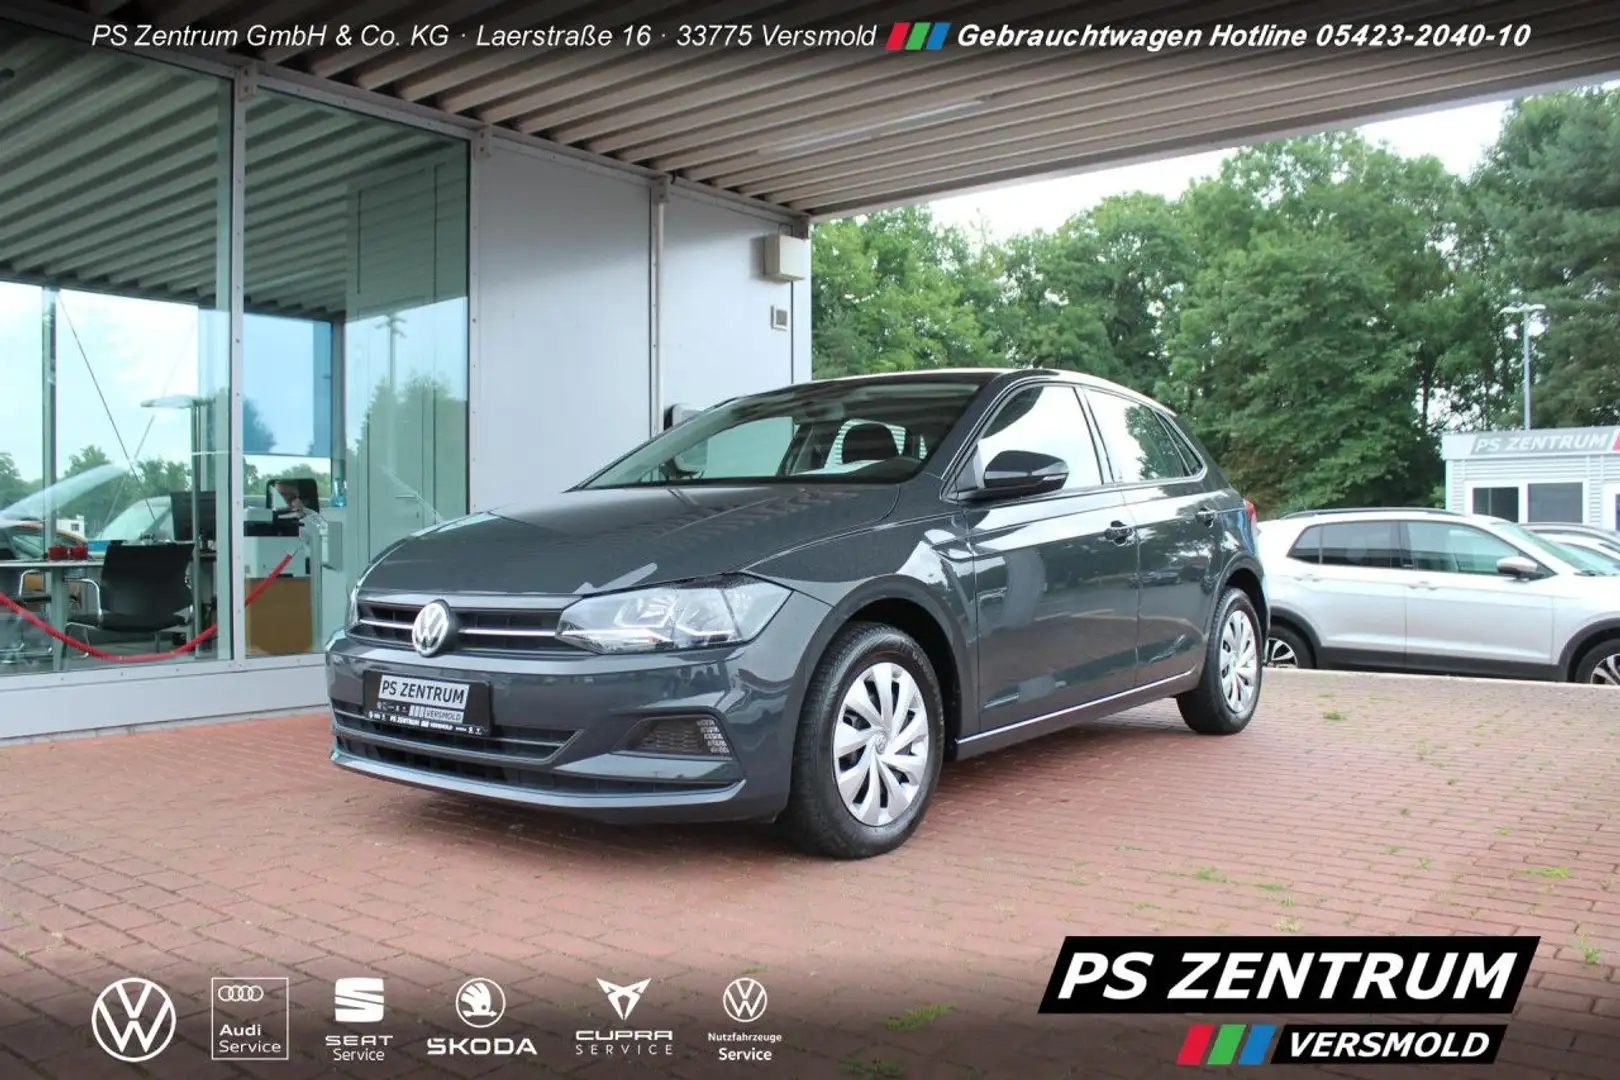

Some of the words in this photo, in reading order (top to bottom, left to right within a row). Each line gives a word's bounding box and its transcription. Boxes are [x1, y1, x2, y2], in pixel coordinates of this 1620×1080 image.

[1474, 437, 1501, 452] PS
[1505, 433, 1610, 451] ZENTRUM
[382, 680, 397, 696] PS
[400, 682, 465, 704] ZENTRUM
[425, 708, 463, 721] VERSMOLD
